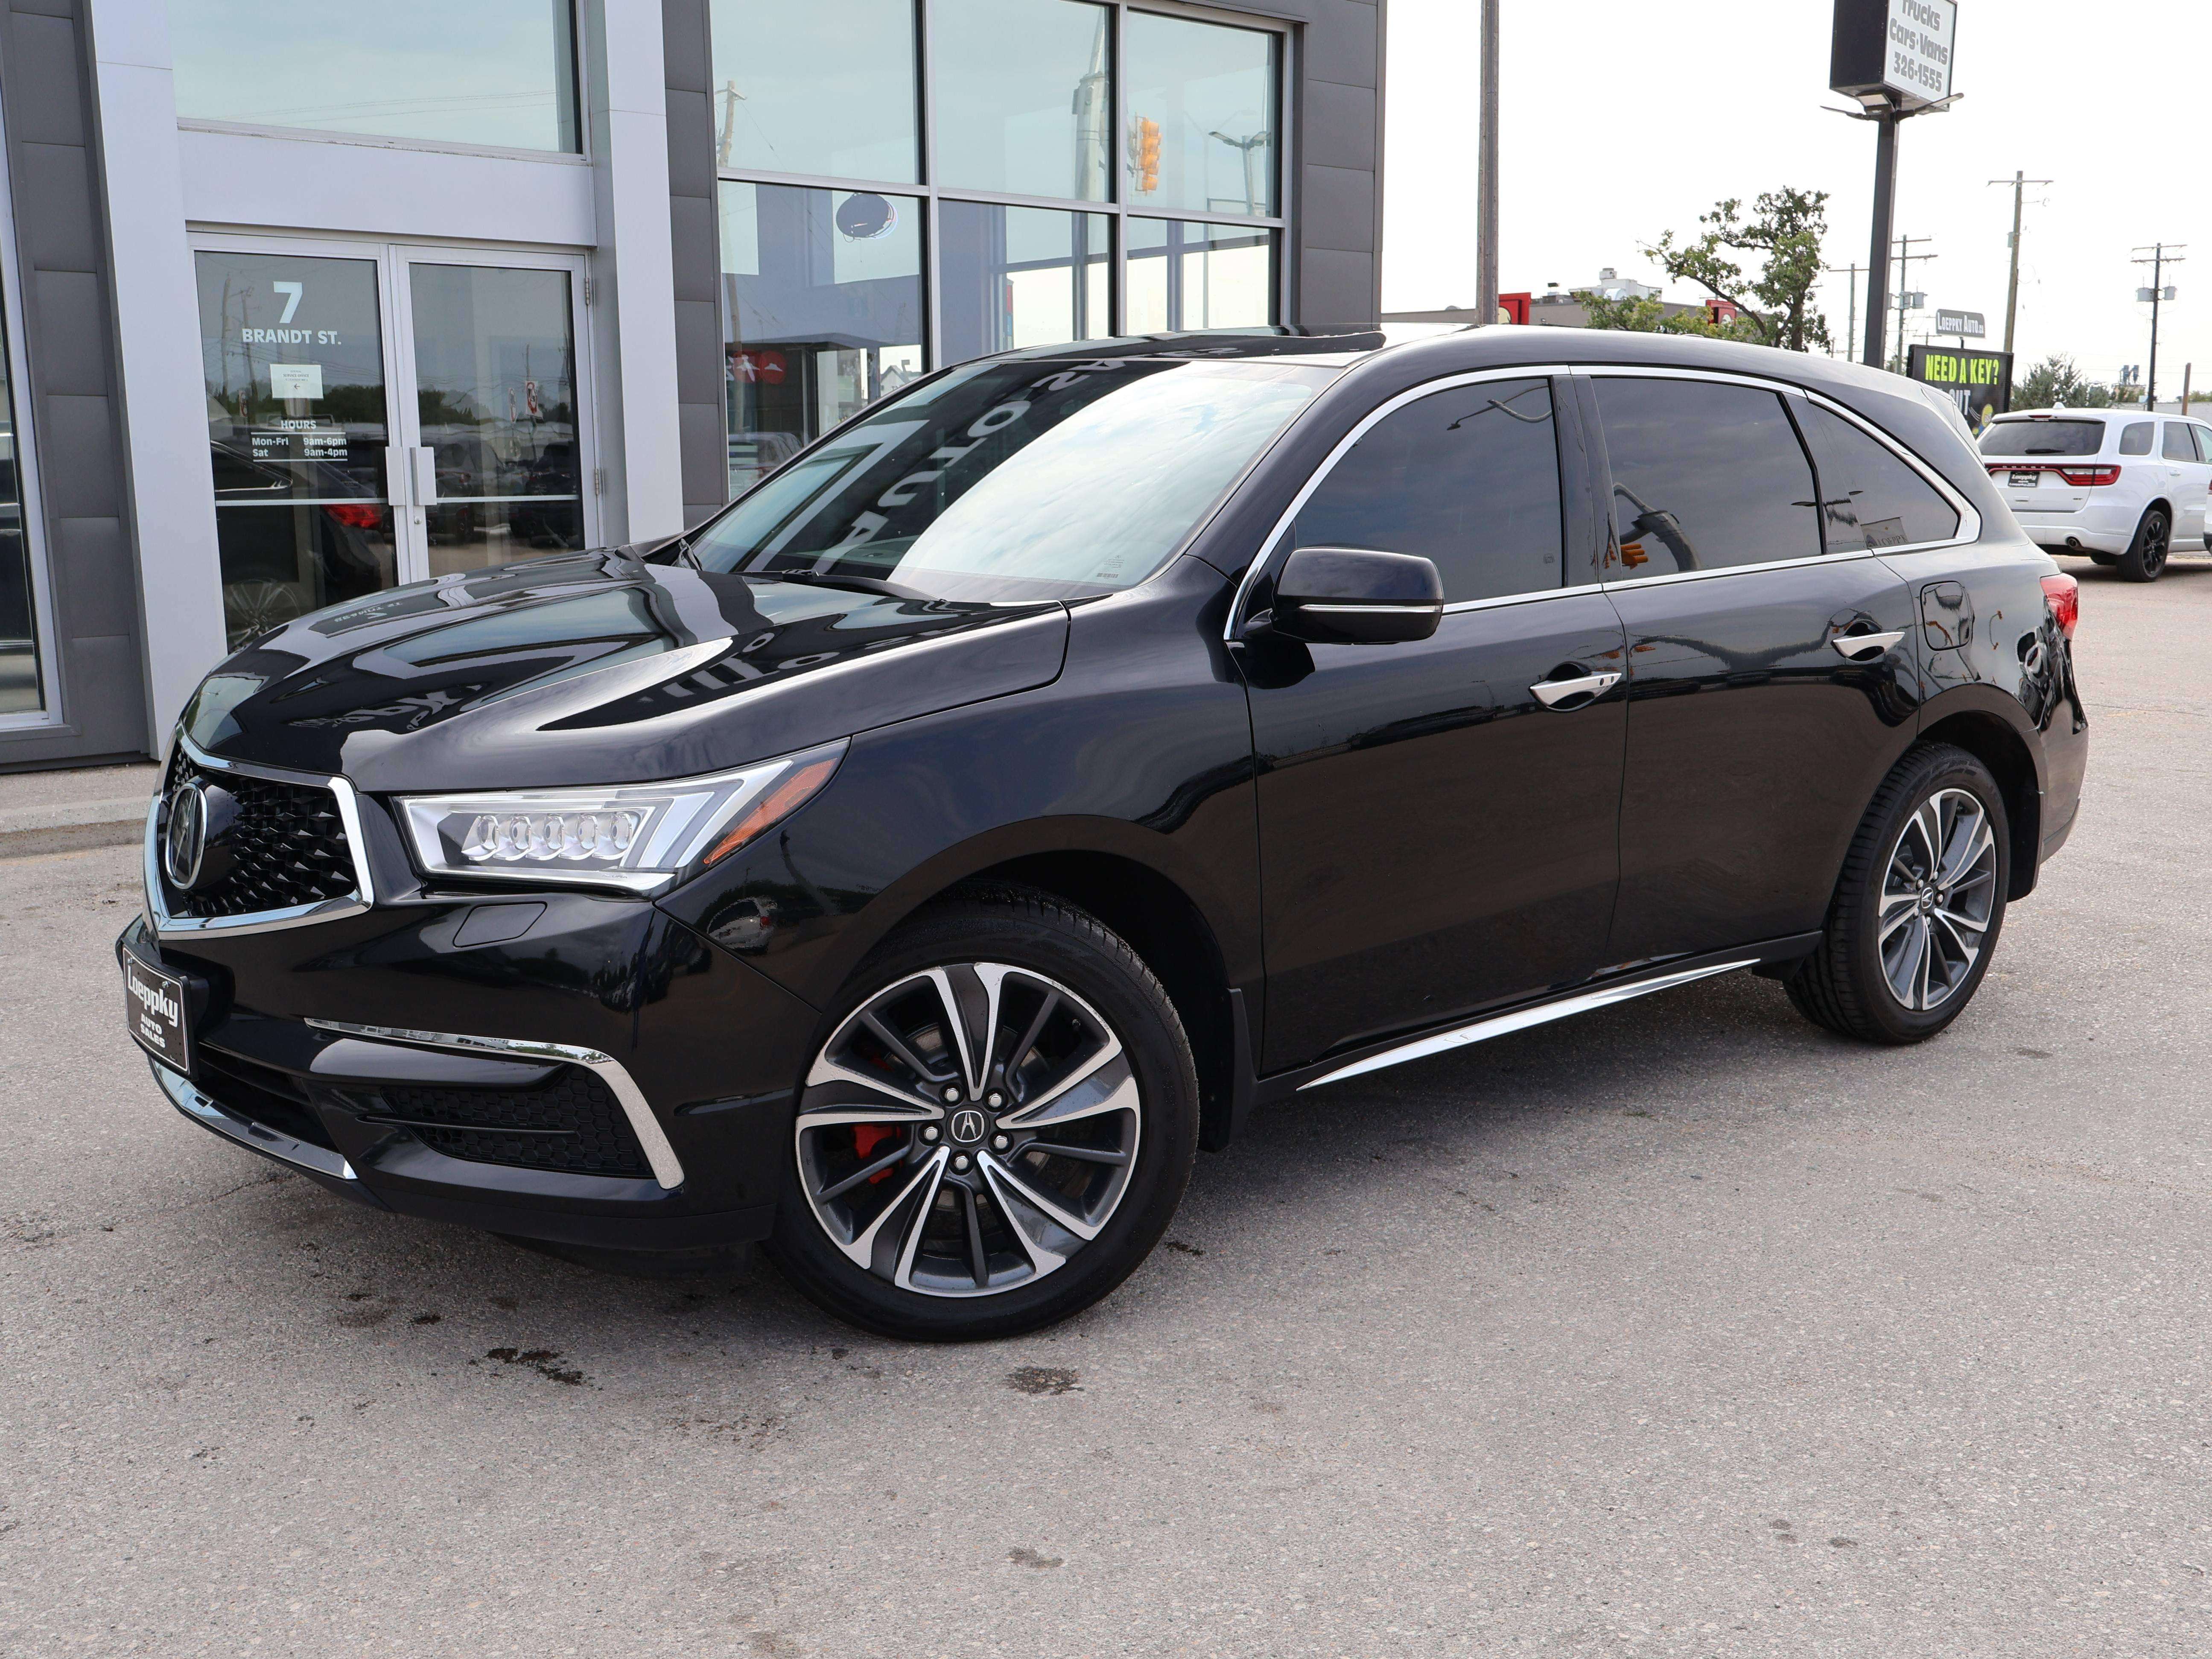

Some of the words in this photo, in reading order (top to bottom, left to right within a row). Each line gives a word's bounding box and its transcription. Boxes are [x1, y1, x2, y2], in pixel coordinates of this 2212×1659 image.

[1894, 51, 1942, 92] 326-1555
[273, 281, 303, 323] 7
[242, 328, 312, 344] BRANDT
[318, 330, 341, 345] ST.
[1925, 354, 1957, 382] NEED
[1959, 358, 1967, 384] A
[1970, 359, 2000, 385] KEY?
[280, 420, 317, 429] HOURS
[252, 437, 289, 446] Mon-Fri
[303, 437, 347, 447] 9am-6pm
[253, 448, 269, 457] Sat
[304, 448, 348, 457] 9am-4pm
[128, 965, 178, 1027] Loeppky
[140, 1013, 162, 1034] AUTO
[140, 1024, 166, 1049] SALES
